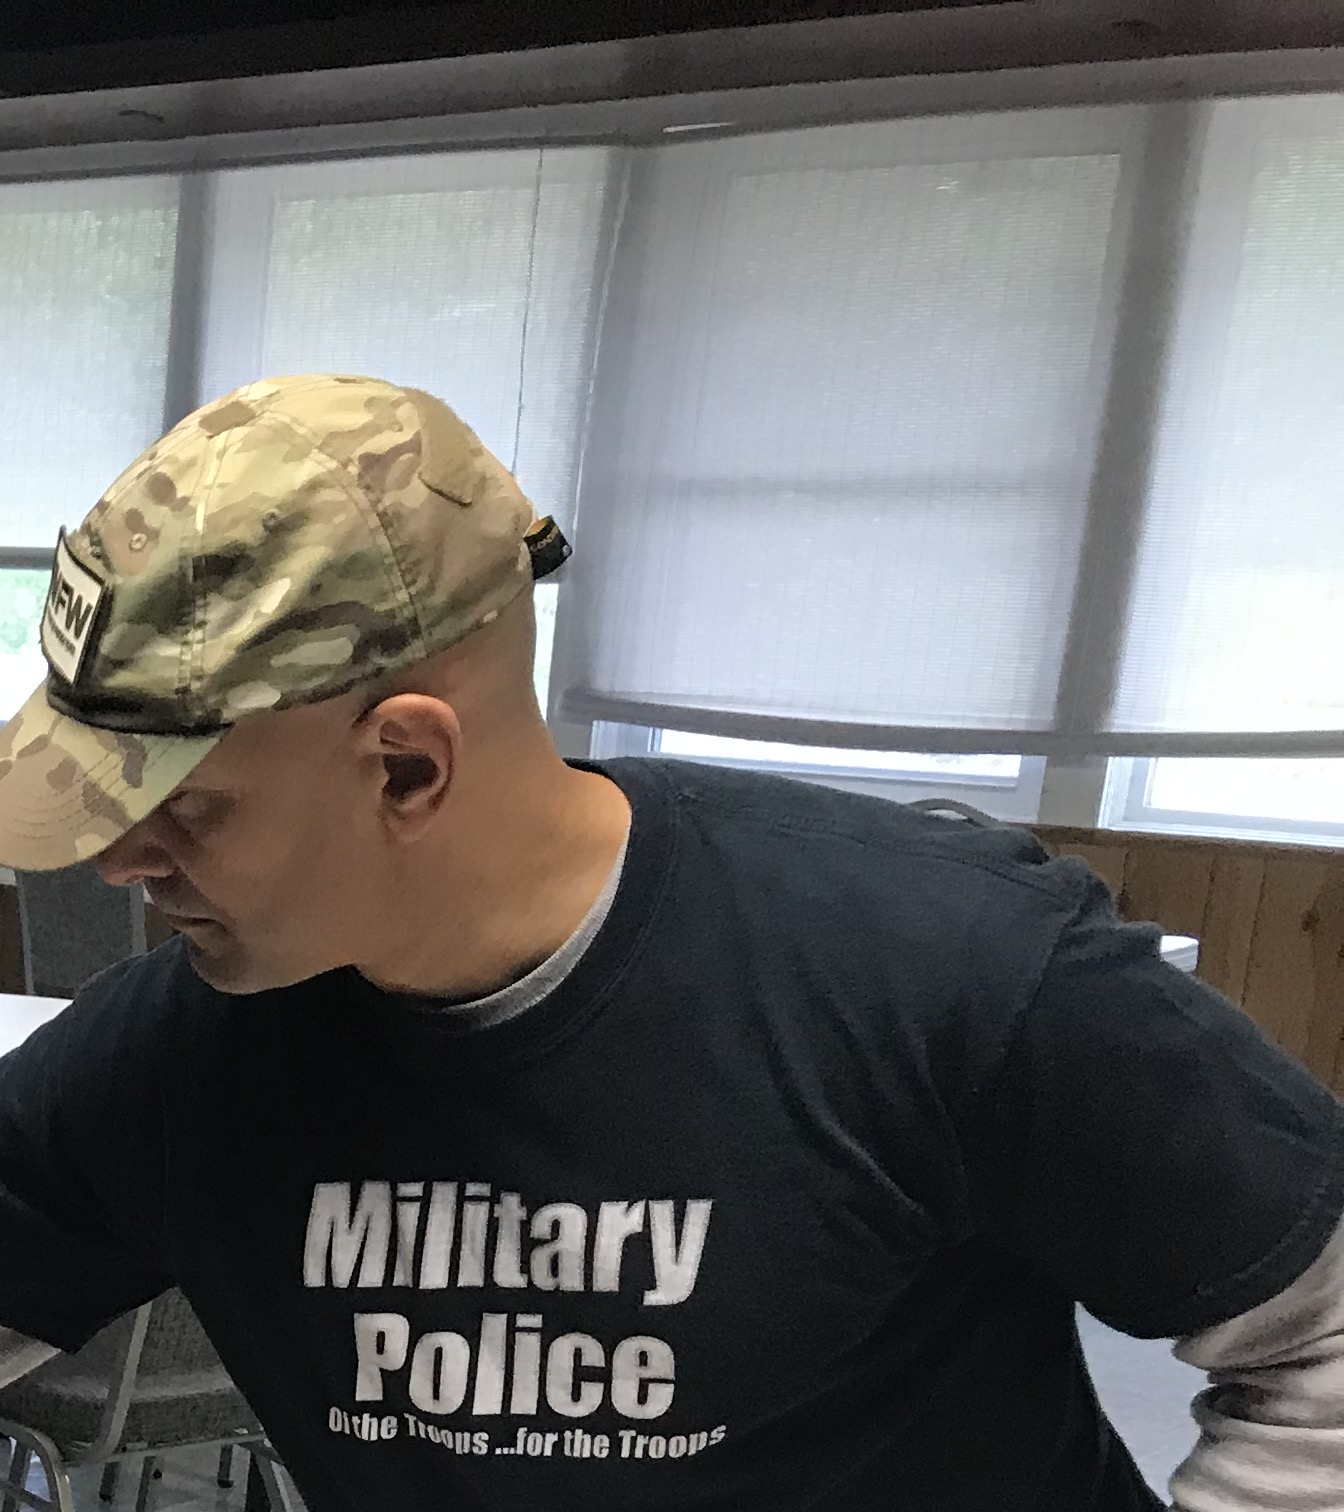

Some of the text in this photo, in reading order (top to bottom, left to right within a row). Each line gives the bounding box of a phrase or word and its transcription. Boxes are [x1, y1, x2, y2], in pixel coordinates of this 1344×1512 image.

[302, 1181, 714, 1306] Military
[354, 1312, 676, 1420] Police
[351, 1409, 398, 1441] the
[405, 1413, 490, 1456] Troops
[563, 1429, 610, 1458] the
[618, 1423, 728, 1460] Troops
